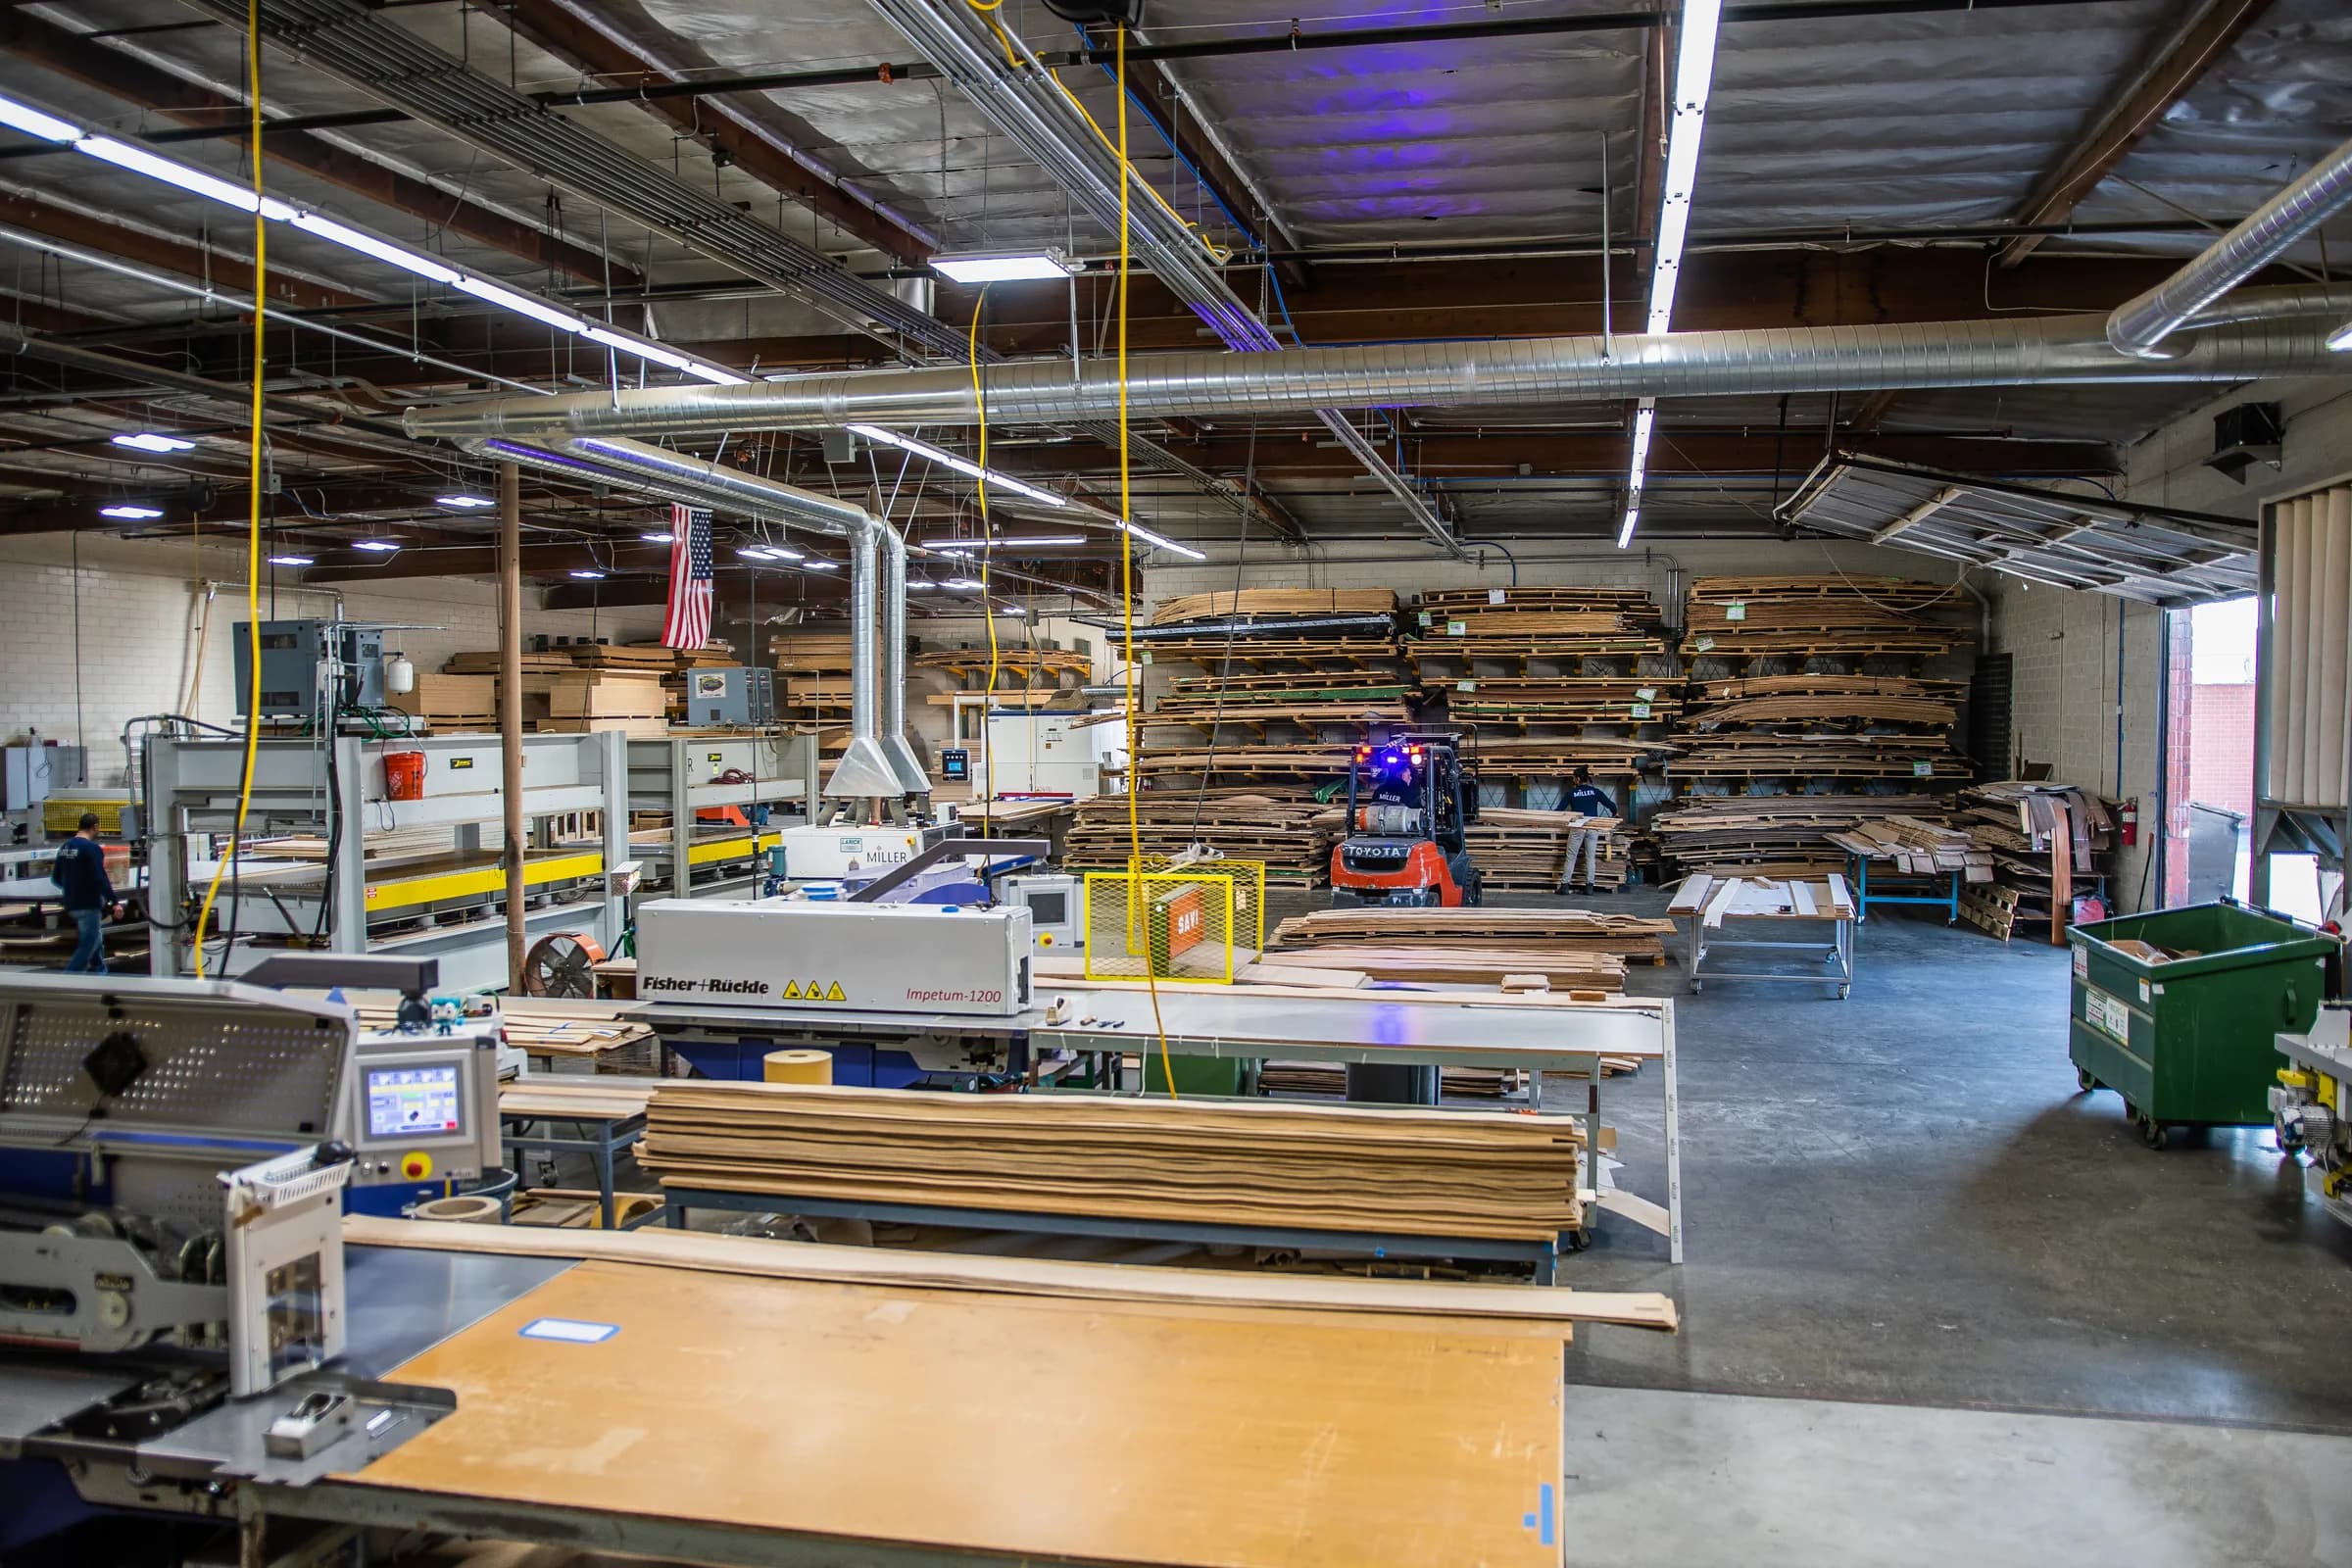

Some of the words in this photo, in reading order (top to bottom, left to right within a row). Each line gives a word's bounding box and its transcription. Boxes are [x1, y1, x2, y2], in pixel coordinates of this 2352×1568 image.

[1379, 792, 1401, 804] MILLER
[1574, 789, 1595, 798] MILLER
[866, 847, 907, 863] MILLER
[1347, 846, 1401, 858] TOYOTA
[642, 976, 769, 995] Fisher+Rückle
[906, 987, 1002, 1004] Impetum-1200
